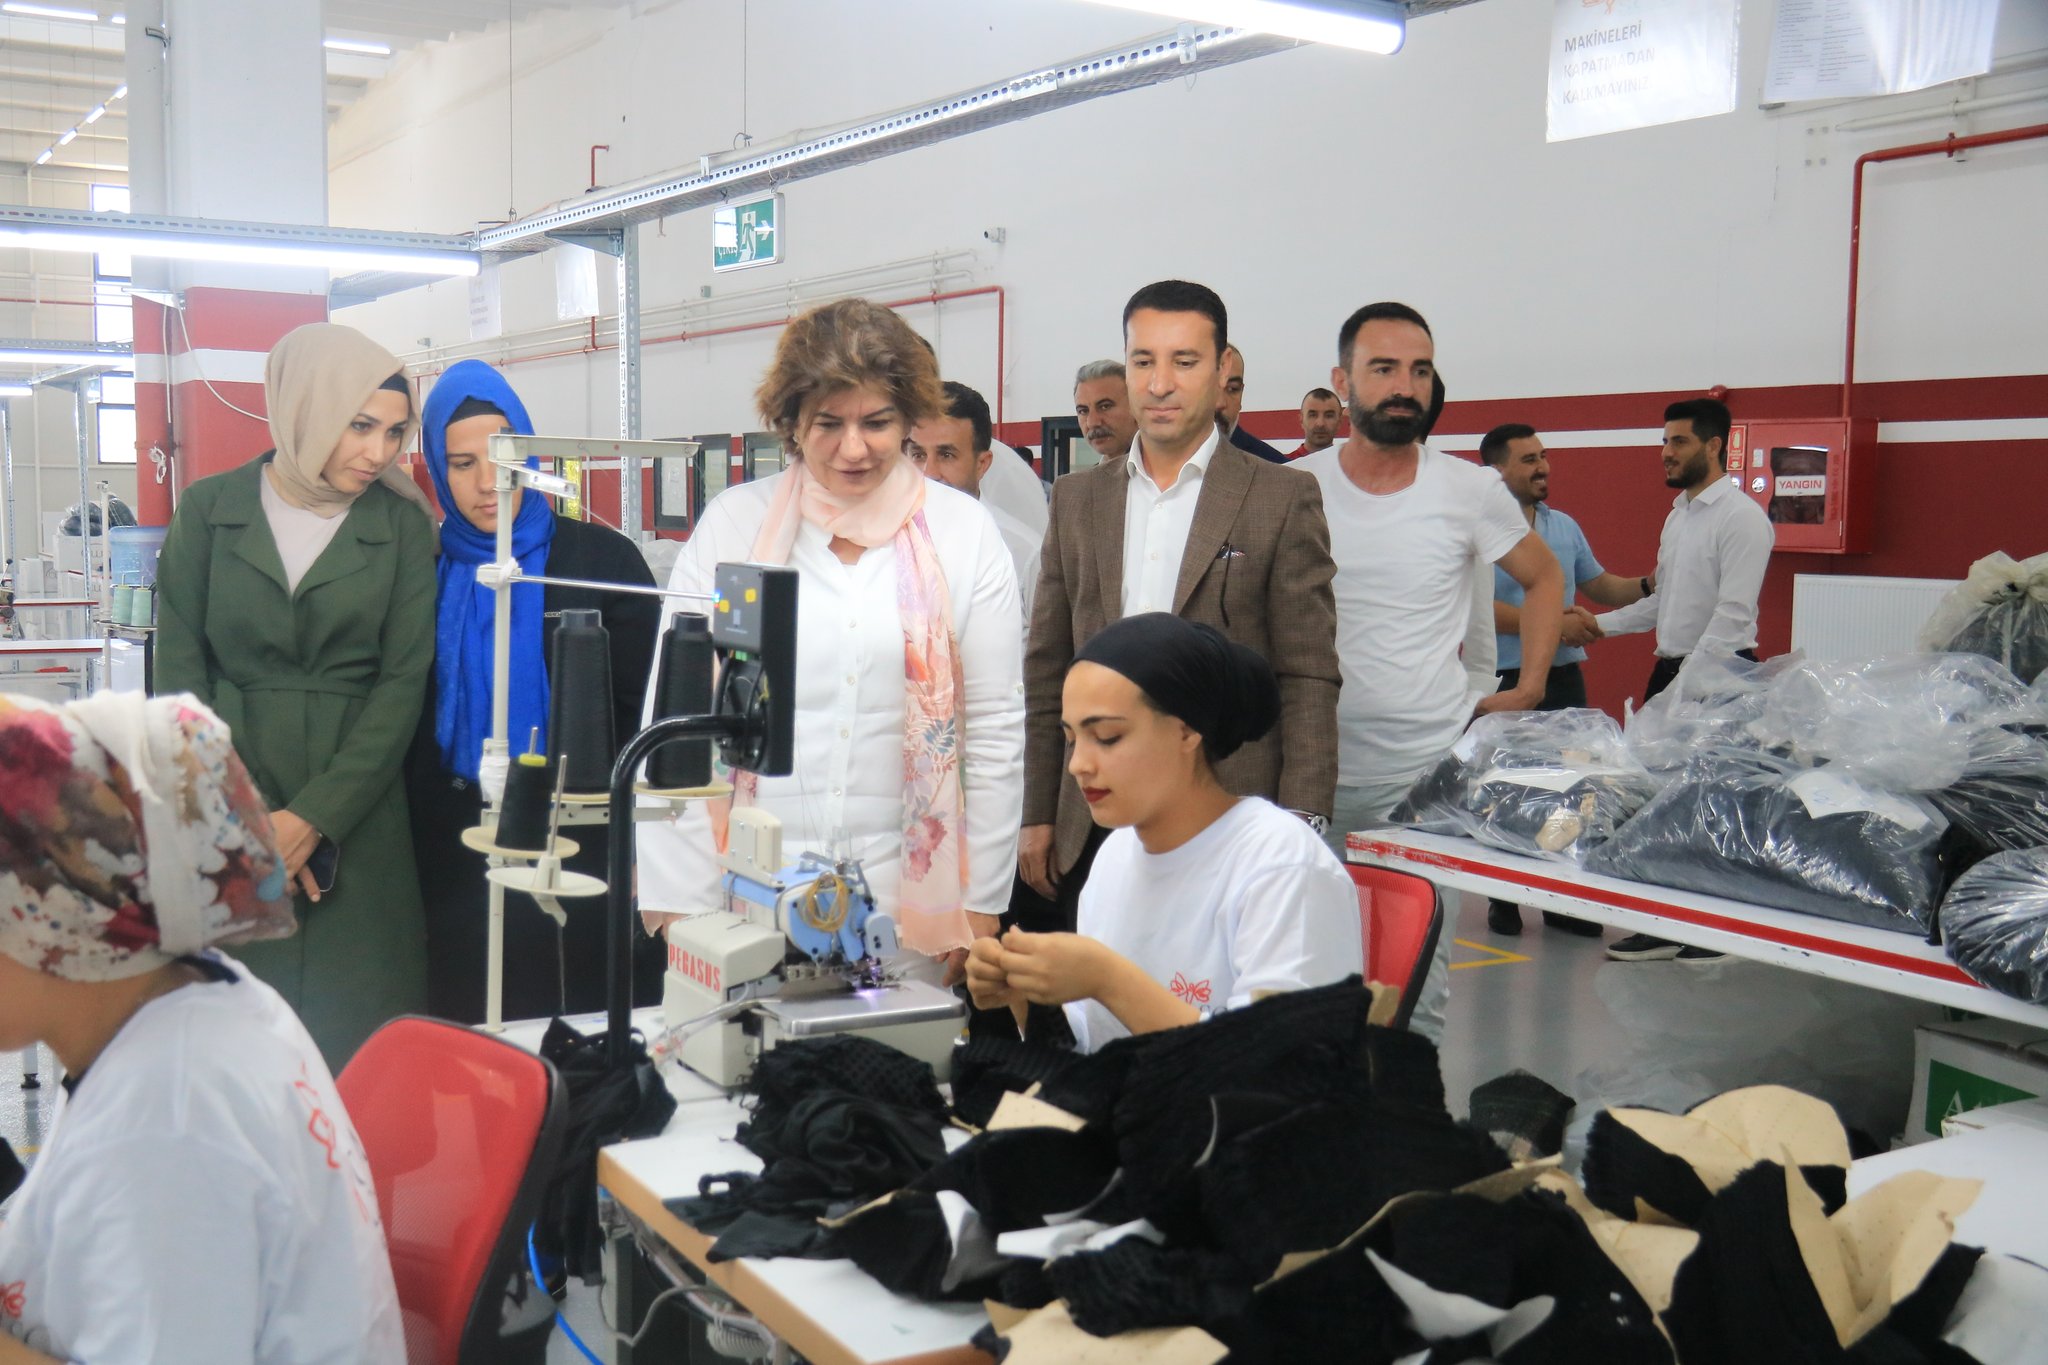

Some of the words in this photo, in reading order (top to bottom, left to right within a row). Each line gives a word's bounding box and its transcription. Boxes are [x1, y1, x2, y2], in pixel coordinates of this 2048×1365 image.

[1564, 19, 1642, 53] MAKİNELERİ
[1563, 48, 1656, 79] KAPATMADAN
[1778, 480, 1822, 489] YANGIN
[669, 943, 721, 992] PEGASUS
